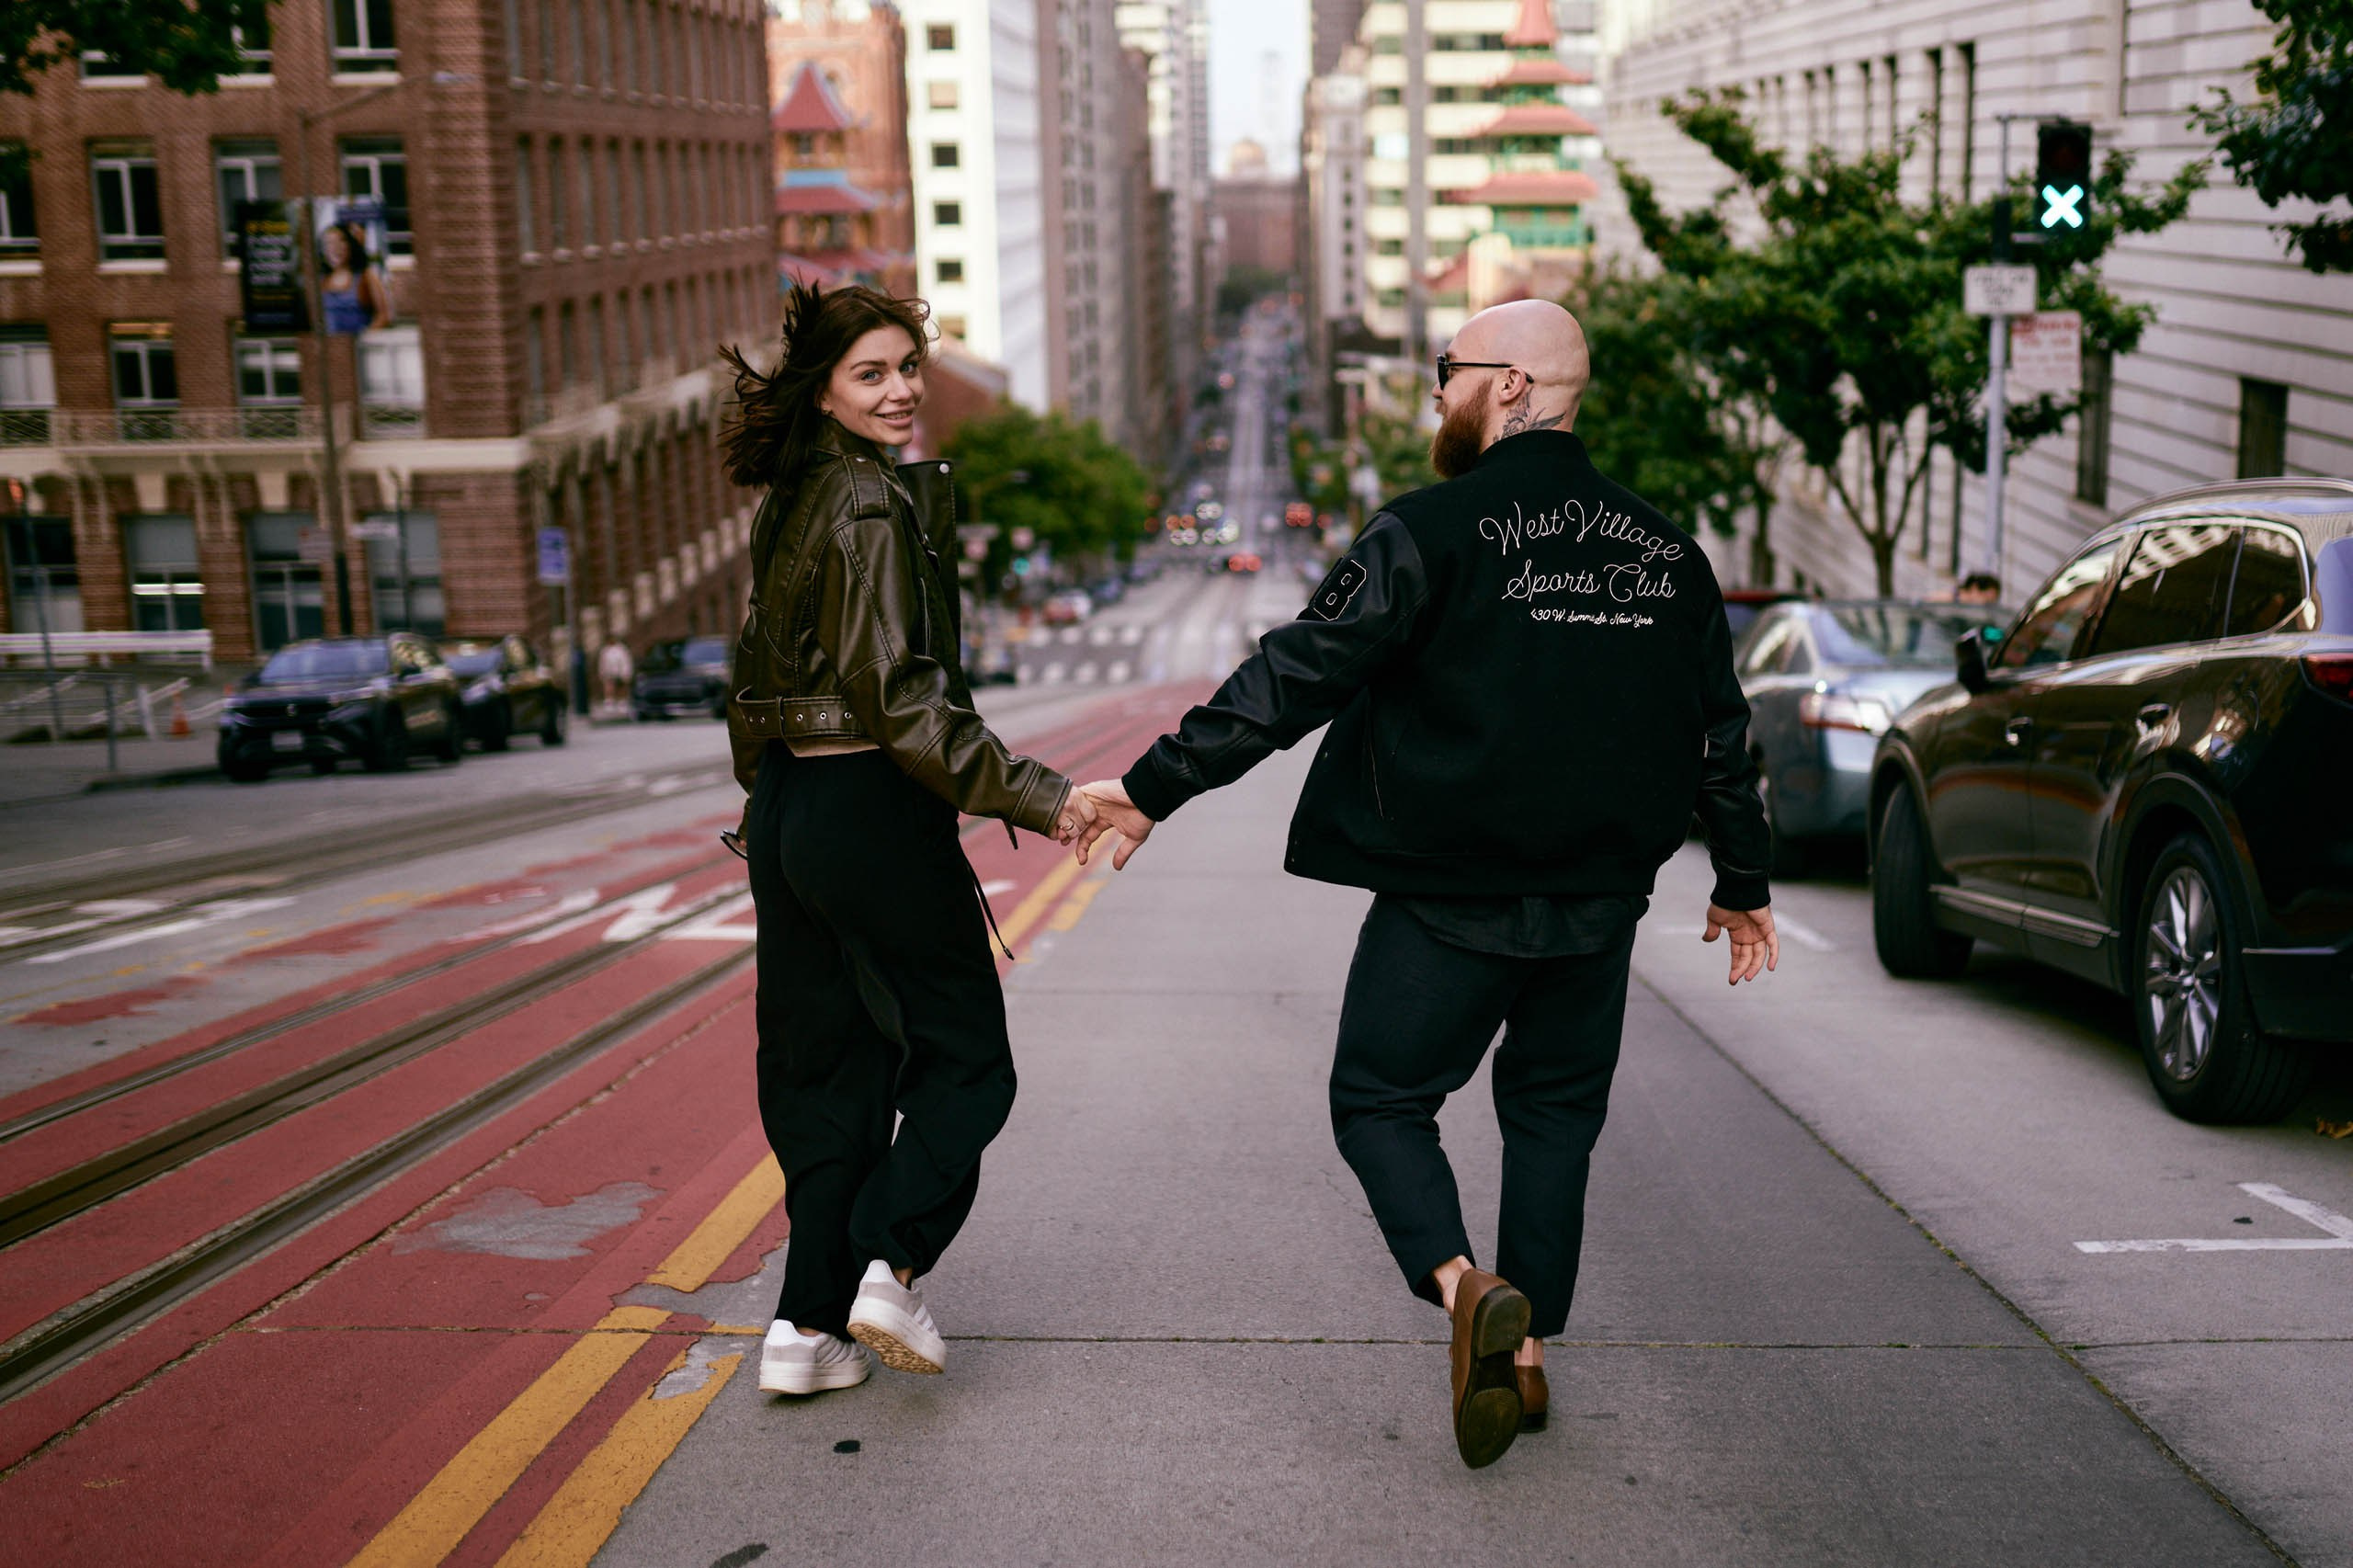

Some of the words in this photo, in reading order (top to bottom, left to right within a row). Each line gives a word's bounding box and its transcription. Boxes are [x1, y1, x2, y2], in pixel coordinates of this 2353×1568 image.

[1479, 501, 1565, 556] West
[1564, 499, 1685, 562] Village
[1501, 558, 1601, 603] Sports
[1603, 562, 1677, 603] Club
[1529, 608, 1551, 621] 430
[1609, 612, 1632, 625] New
[1631, 612, 1654, 629] York
